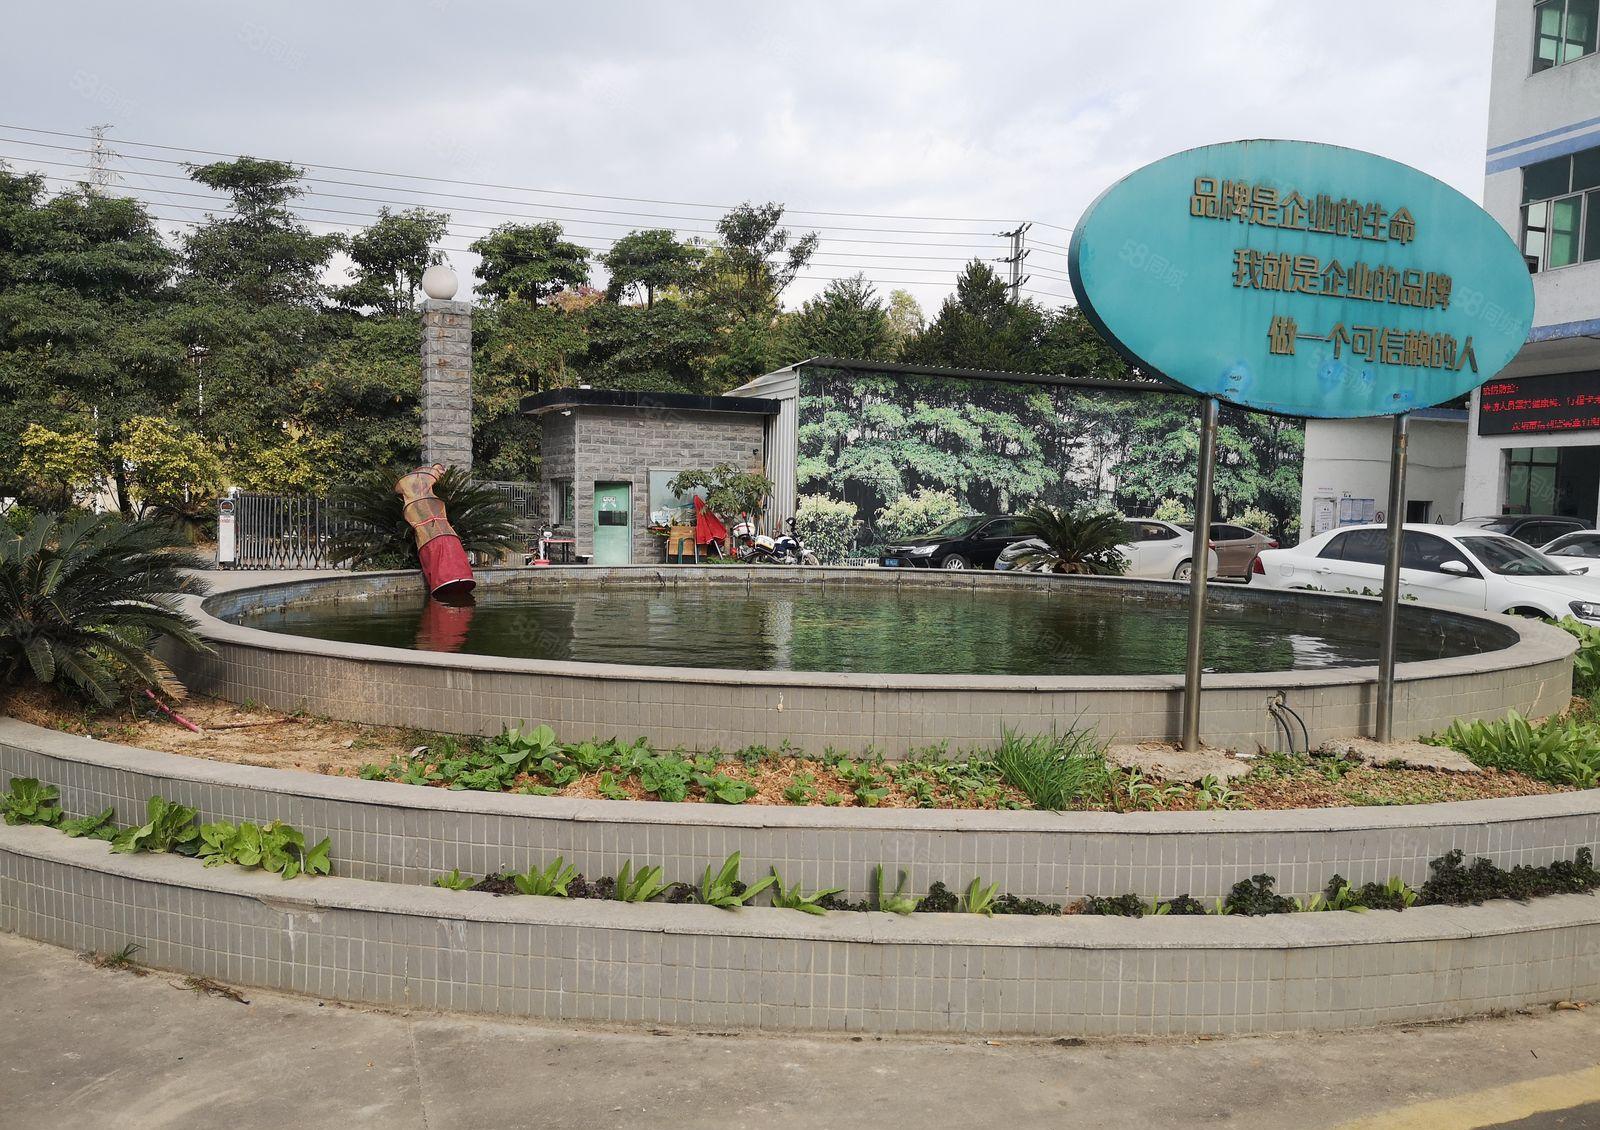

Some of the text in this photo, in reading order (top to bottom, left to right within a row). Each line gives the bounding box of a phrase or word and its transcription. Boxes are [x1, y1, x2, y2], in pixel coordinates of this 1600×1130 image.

[1190, 176, 1416, 246] 品牌是企业的生命
[1232, 248, 1453, 311] 我就是企业的品牌
[1267, 315, 1480, 374] 做一个可信赖的人
